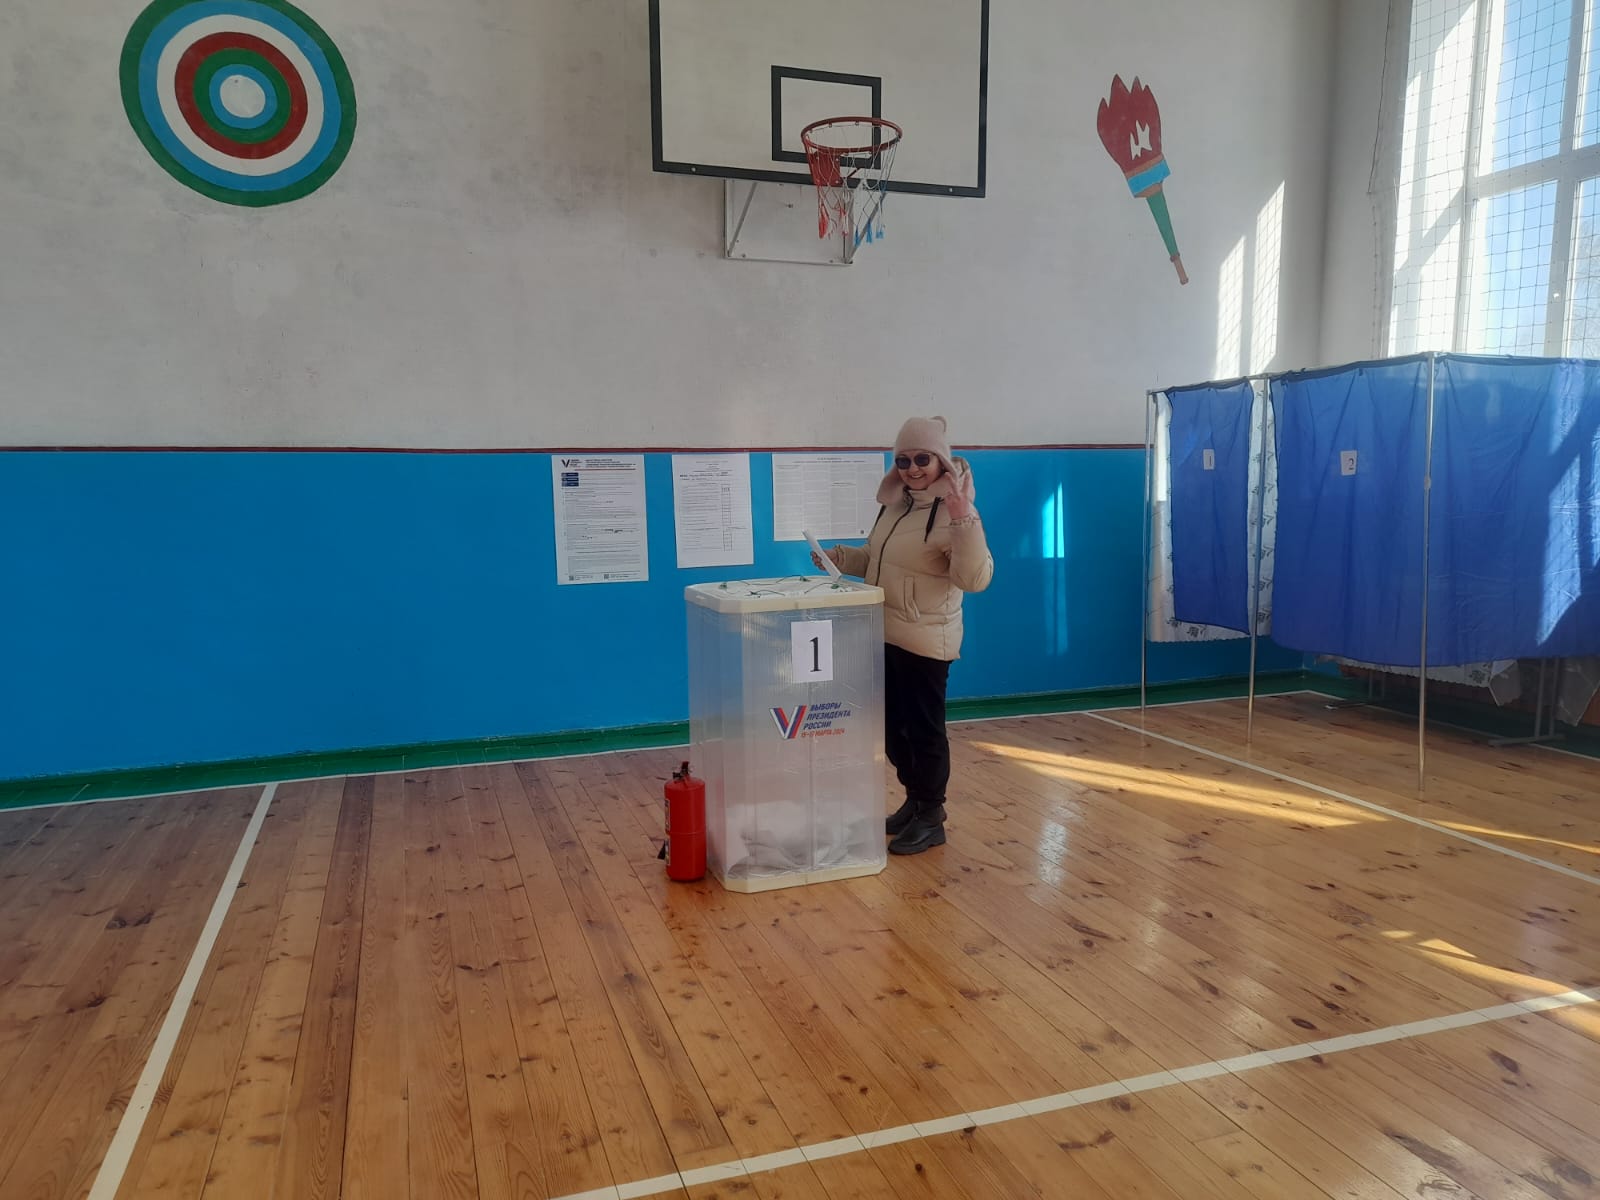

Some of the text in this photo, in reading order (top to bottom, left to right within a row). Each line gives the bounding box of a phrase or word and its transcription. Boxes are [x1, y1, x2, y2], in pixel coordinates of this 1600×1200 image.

[1348, 457, 1355, 471] 2
[809, 636, 823, 673] 1
[810, 702, 842, 711] ВЫБОРЫ
[806, 710, 851, 721] ПРЕЗИДЕНТА
[803, 721, 832, 730] РОССИИ
